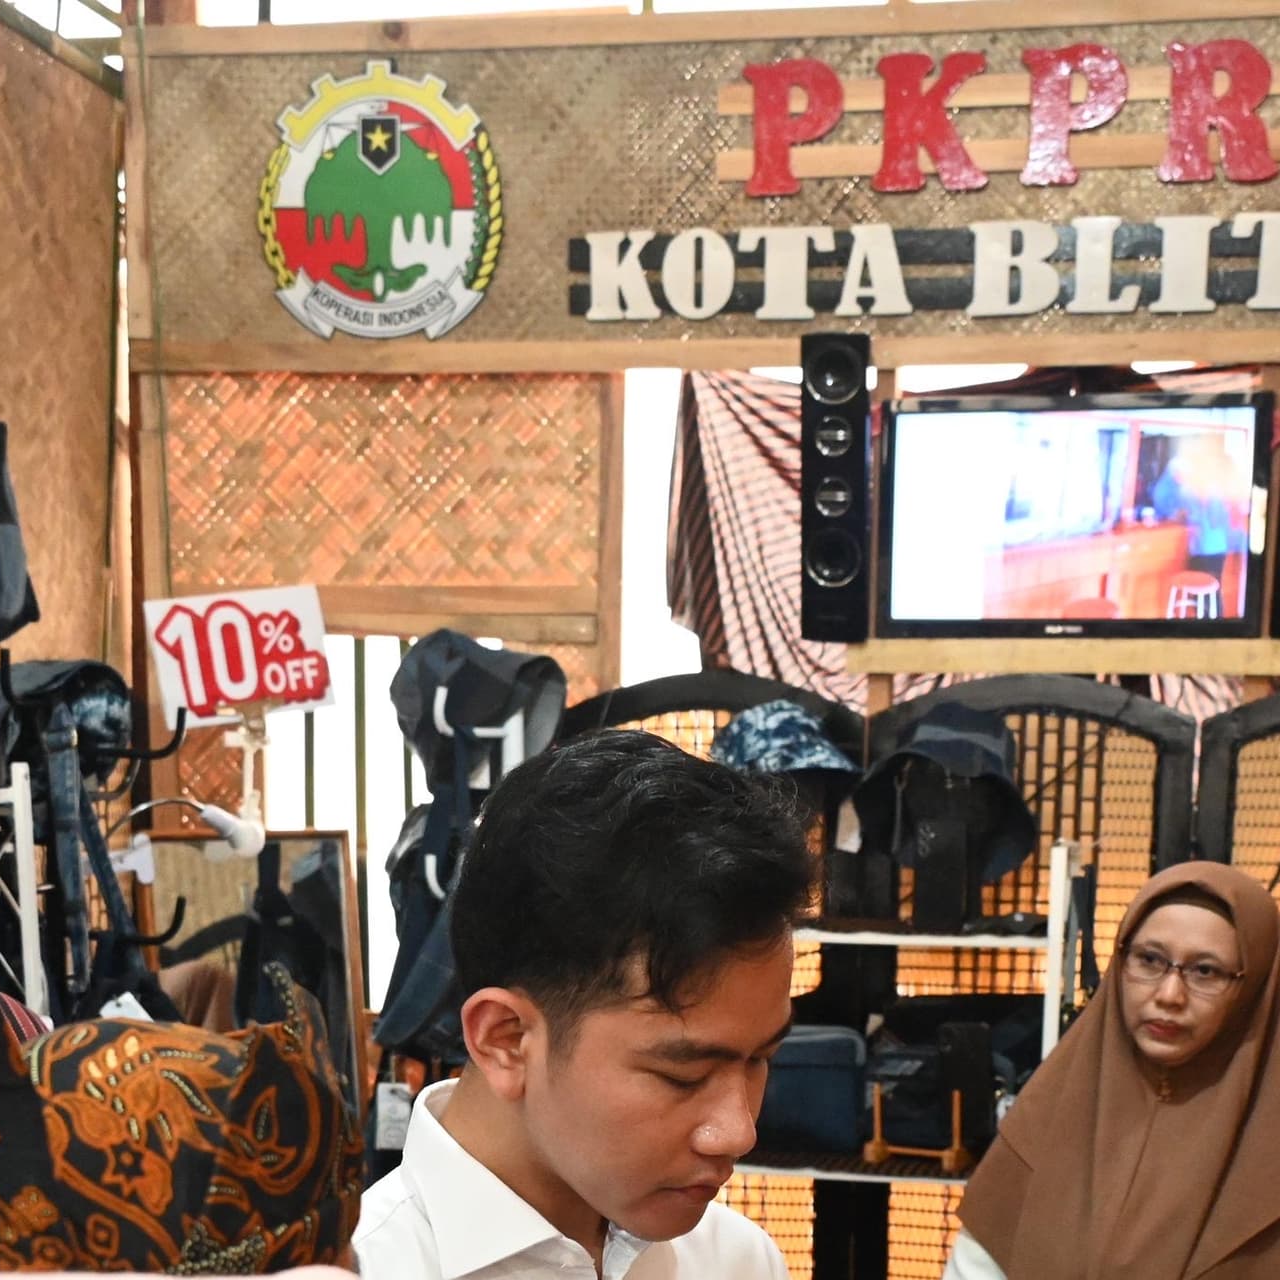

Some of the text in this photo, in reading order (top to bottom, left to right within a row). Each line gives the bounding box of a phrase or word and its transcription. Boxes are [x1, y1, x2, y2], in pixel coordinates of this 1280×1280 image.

[311, 286, 449, 327] KOPERASI INDONESIA
[585, 221, 914, 323] KOTA
[157, 602, 297, 708] 10%
[263, 656, 319, 694] OFF
